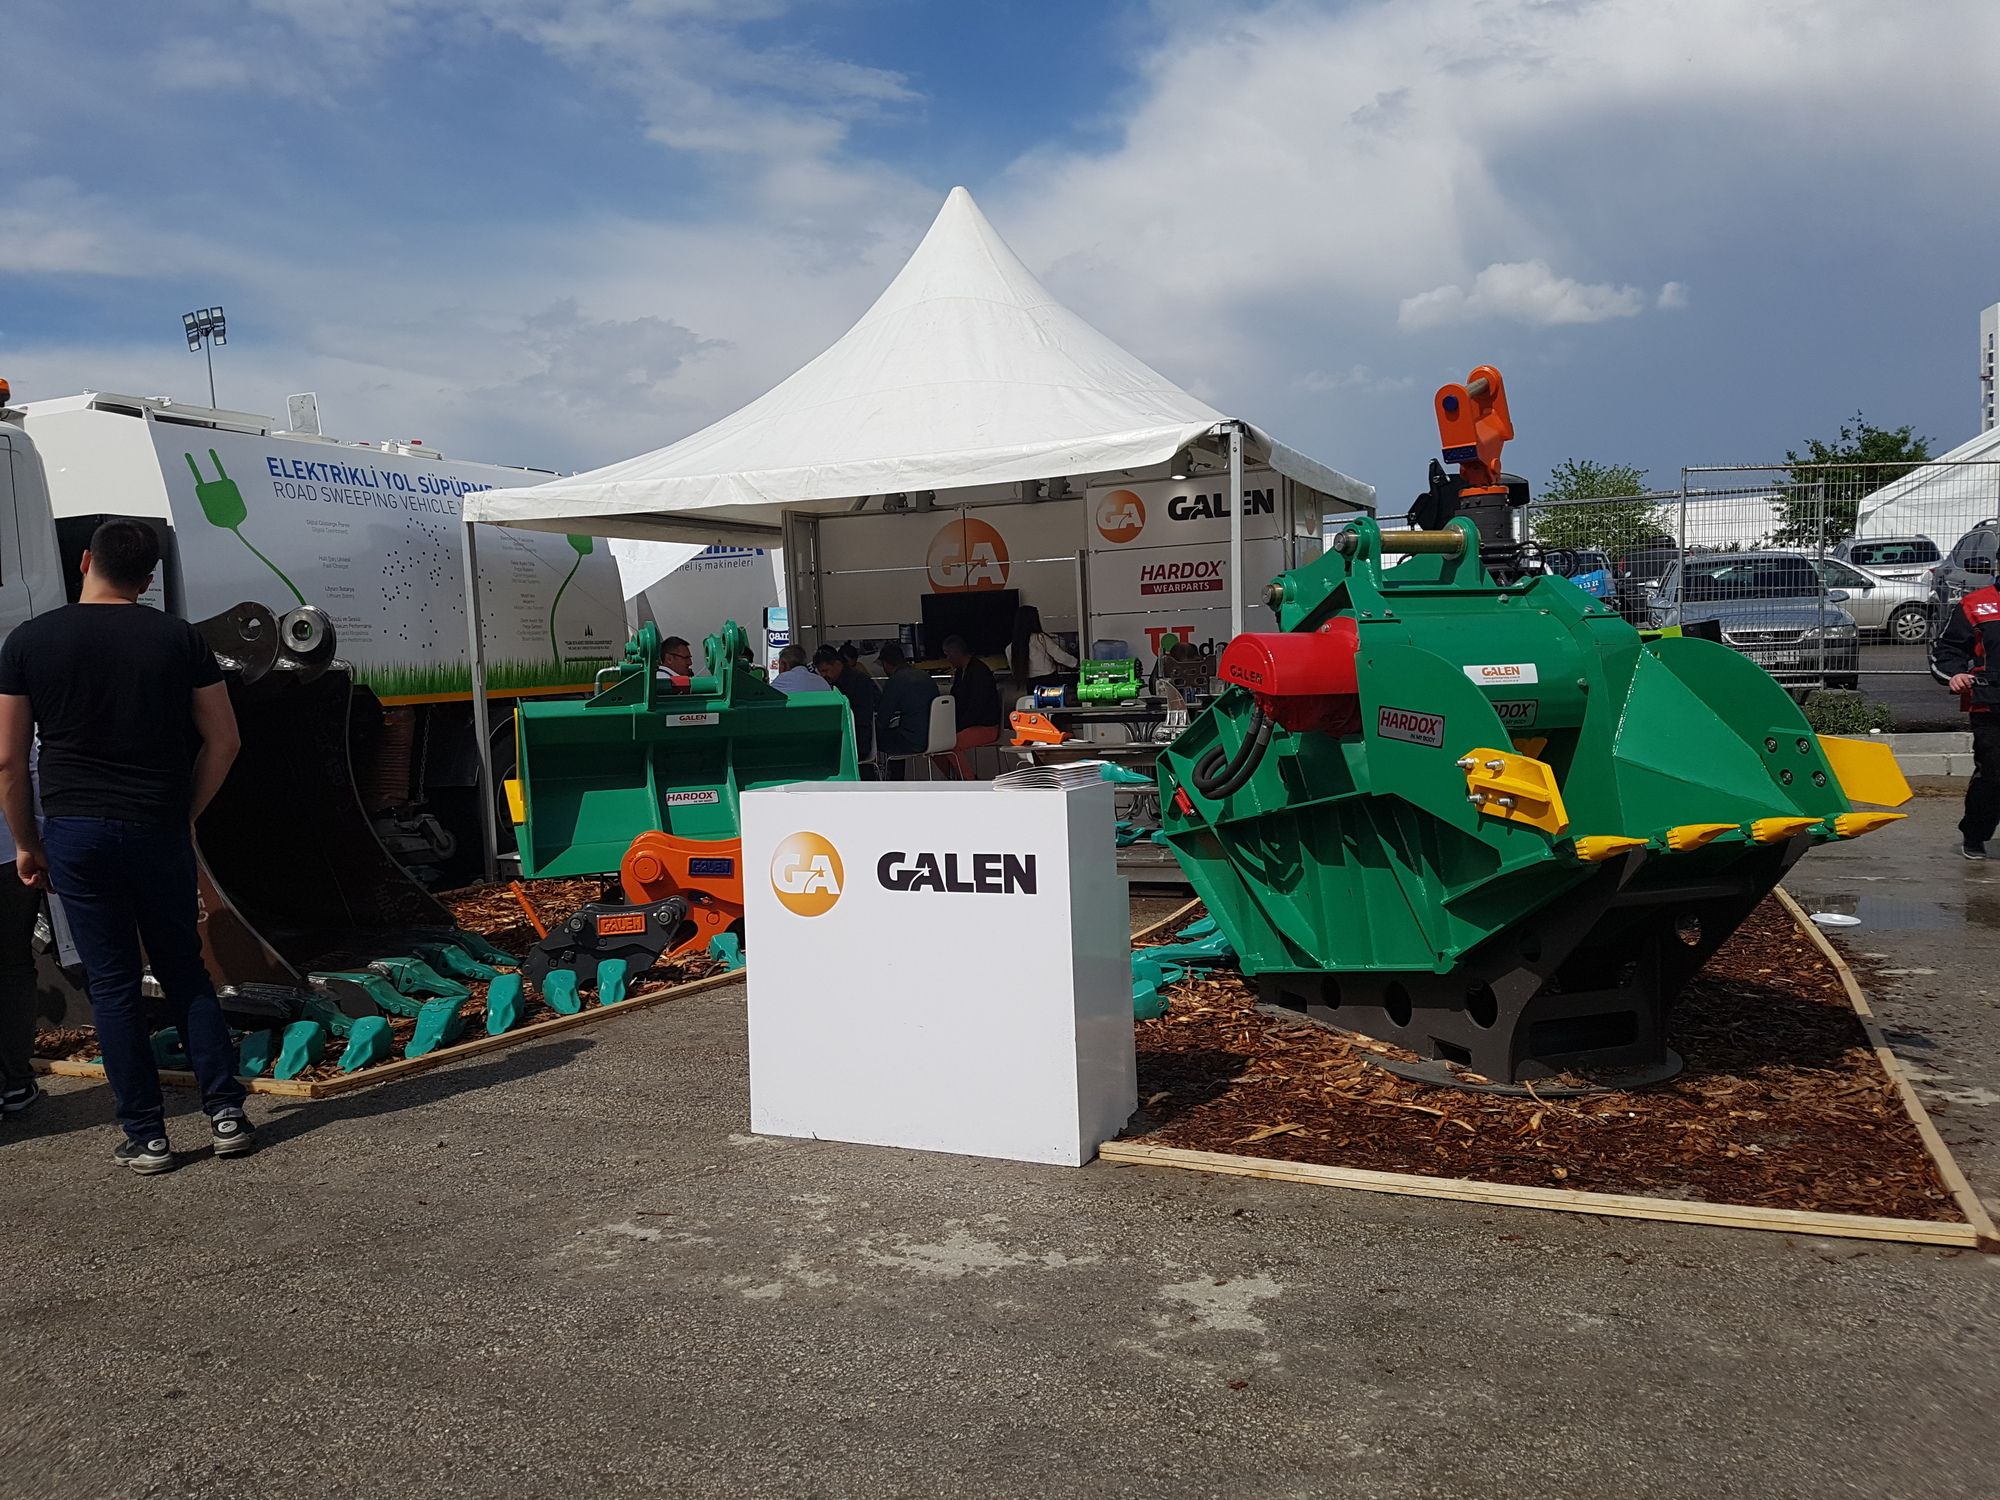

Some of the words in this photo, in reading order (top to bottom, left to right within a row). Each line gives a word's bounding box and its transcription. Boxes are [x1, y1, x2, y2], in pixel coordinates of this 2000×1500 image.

[266, 456, 379, 488] ELEKTRİKLİ
[380, 471, 416, 493] YOL
[418, 473, 493, 498] SÜPÜR
[273, 482, 317, 501] ROAD
[321, 487, 397, 510] SWEEPING
[399, 495, 457, 515] VEHICLE
[1168, 488, 1275, 521] GALEN
[1098, 503, 1143, 530] GA
[695, 561, 702, 572] iş
[705, 558, 753, 570] makineleri
[929, 542, 1006, 587] GA
[1141, 560, 1222, 581] HARDOX
[1153, 582, 1210, 593] WEARPARTS
[1230, 664, 1263, 685] GALEN
[1481, 666, 1520, 676] GALEN
[1380, 711, 1438, 735] HARDOX
[667, 791, 713, 802] HARDOX
[771, 853, 841, 895] GA
[877, 851, 1038, 895] GALEN
[602, 916, 642, 932] GALEN
